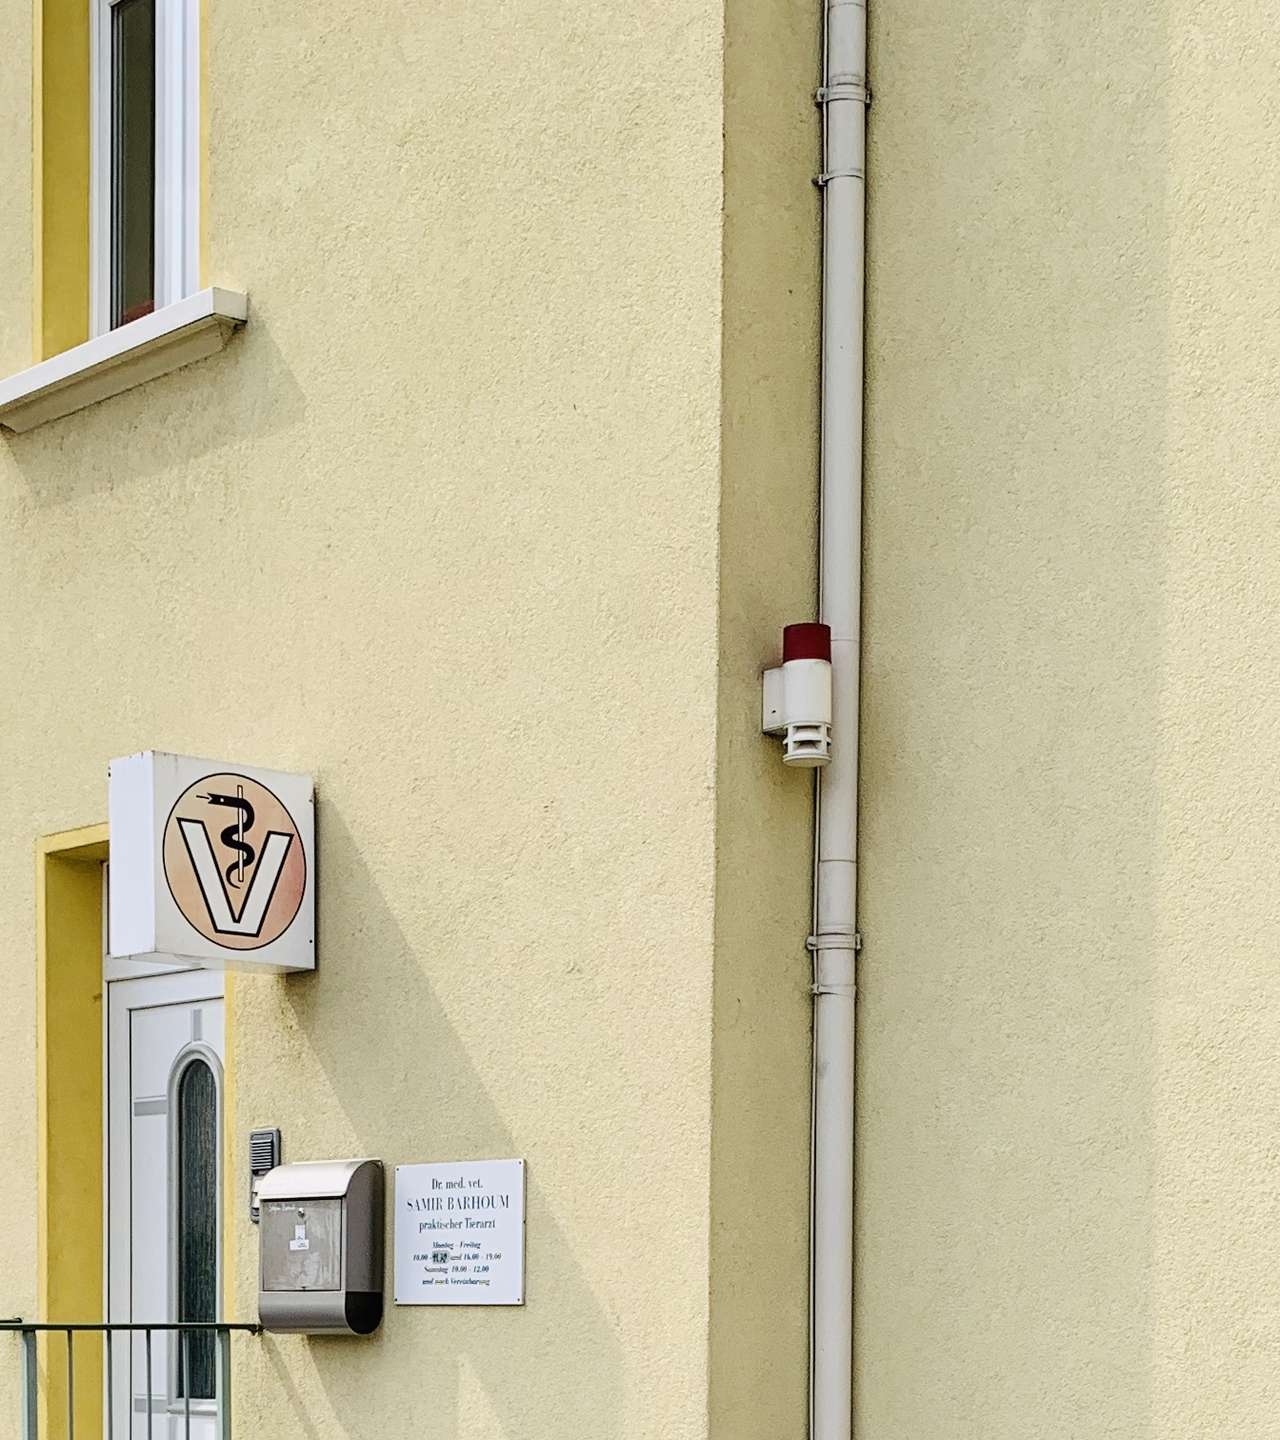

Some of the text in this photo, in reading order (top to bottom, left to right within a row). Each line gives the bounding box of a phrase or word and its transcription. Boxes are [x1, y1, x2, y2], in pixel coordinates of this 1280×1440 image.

[176, 816, 294, 938] V
[431, 1176, 483, 1190] Dr. med. vet.
[406, 1194, 509, 1211] SAMIR BARHOUM
[419, 1217, 496, 1233] praktischer Tierarzt
[460, 1240, 481, 1250] Freitag
